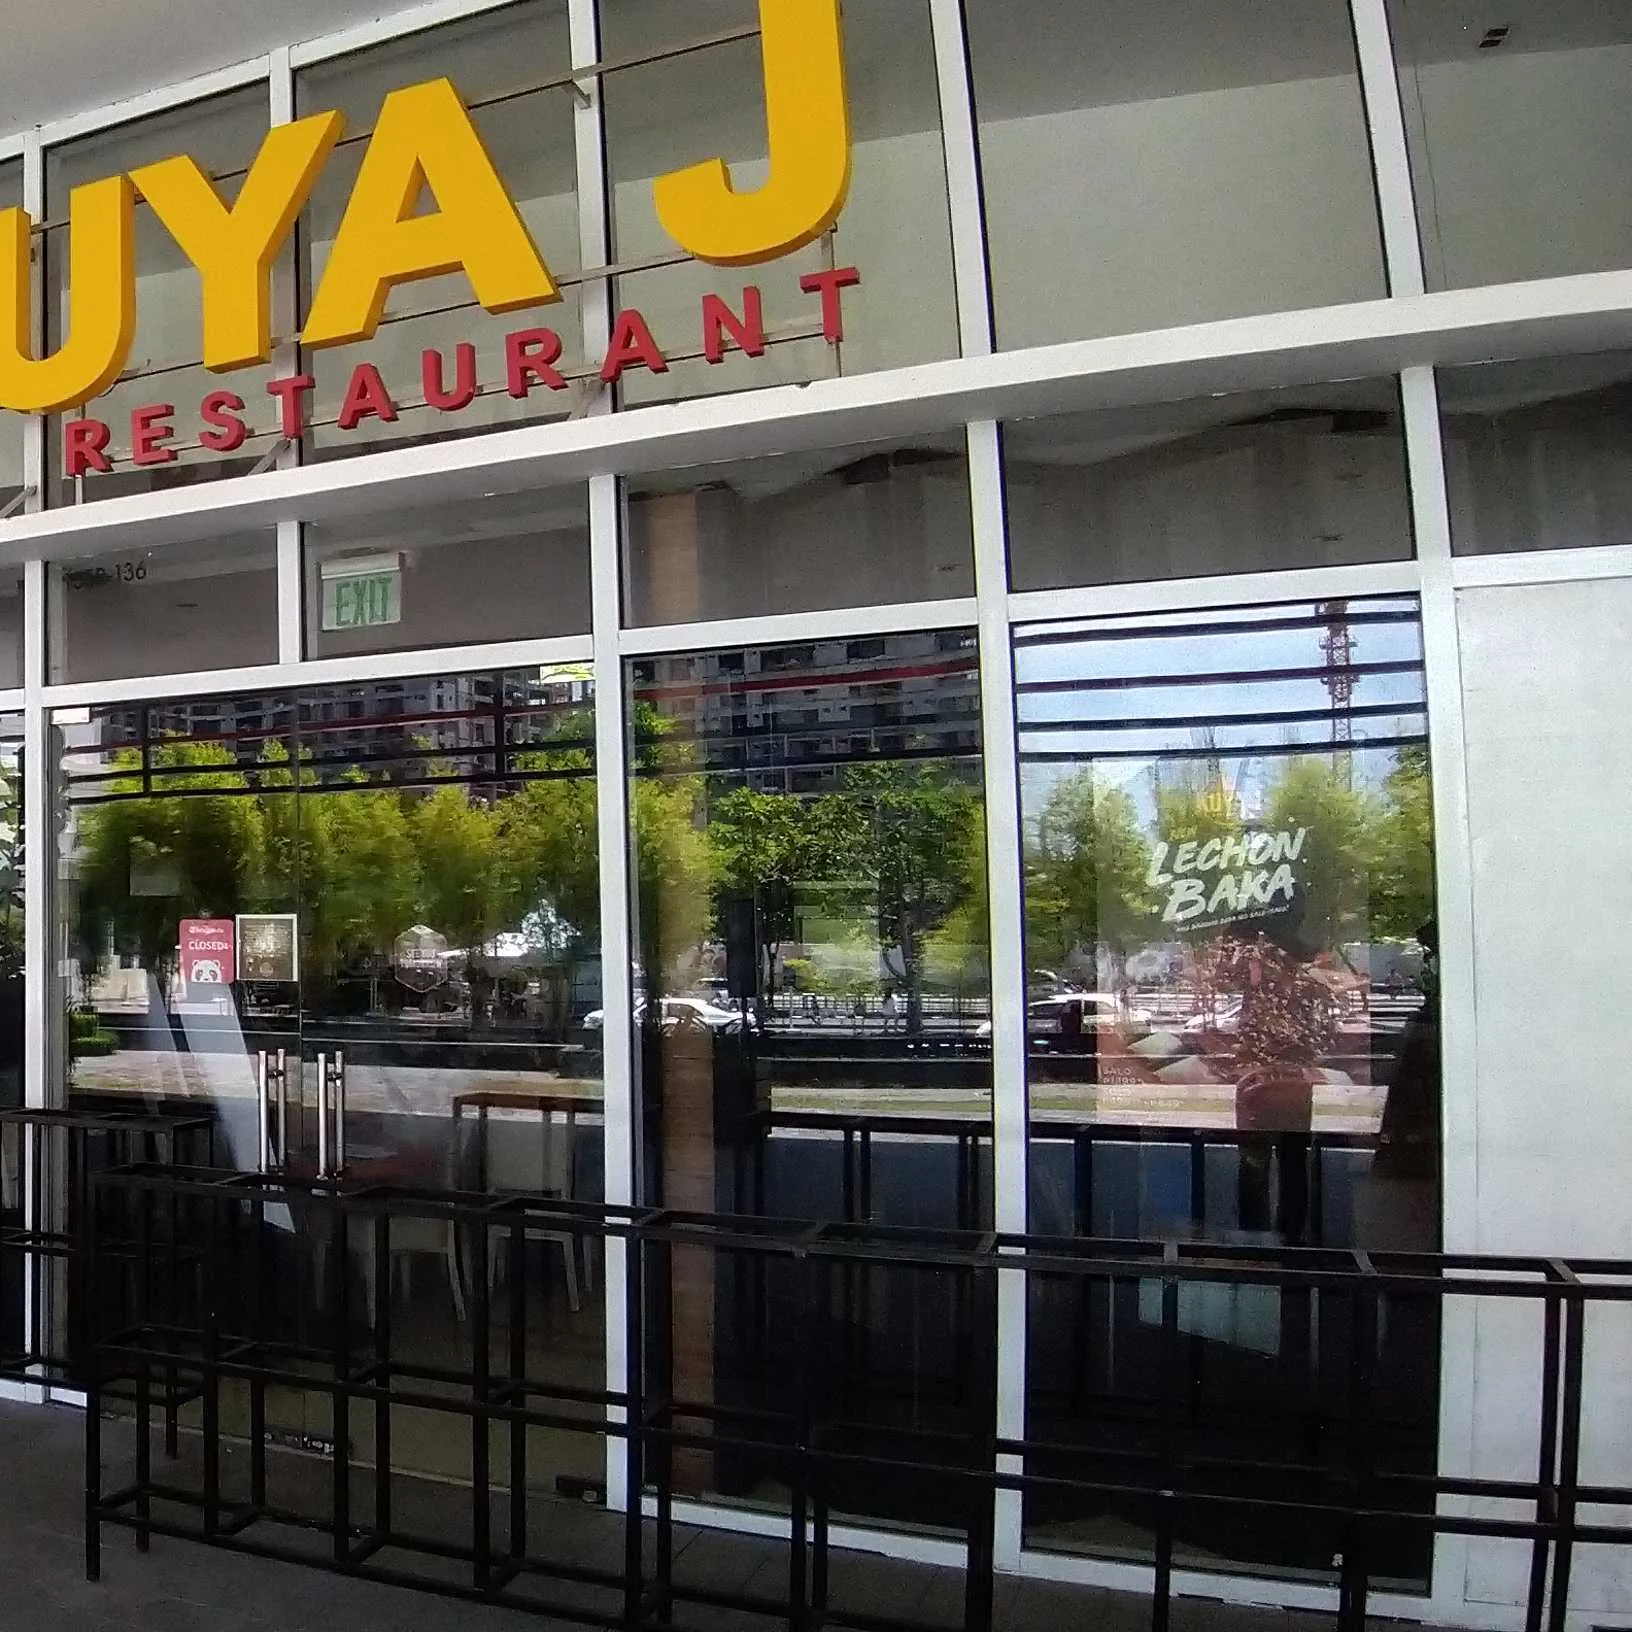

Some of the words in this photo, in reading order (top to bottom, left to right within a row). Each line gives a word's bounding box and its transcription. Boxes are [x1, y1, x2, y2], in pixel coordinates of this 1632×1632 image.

[652, 0, 852, 267] J
[65, 266, 861, 477] RESTAURANT
[335, 576, 393, 627] EXIT
[1148, 825, 1310, 889] LECHON
[1161, 863, 1298, 923] BAKA
